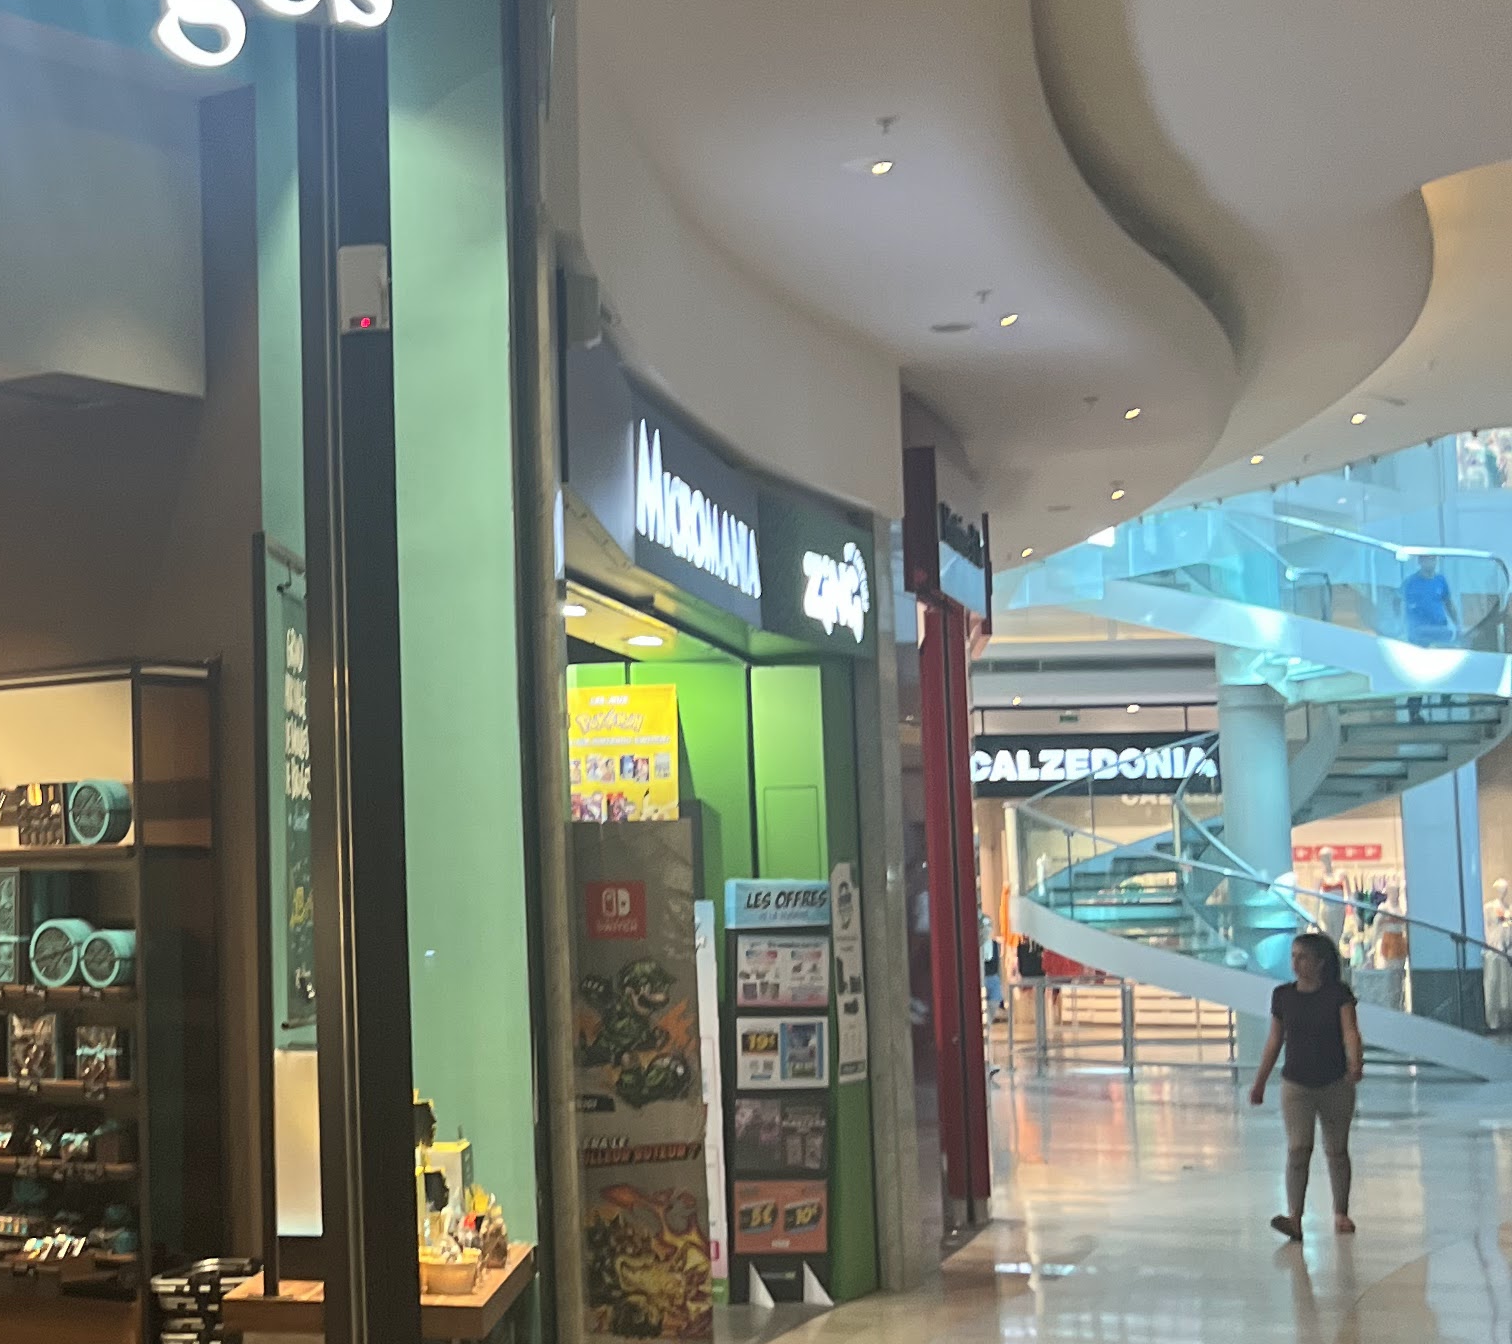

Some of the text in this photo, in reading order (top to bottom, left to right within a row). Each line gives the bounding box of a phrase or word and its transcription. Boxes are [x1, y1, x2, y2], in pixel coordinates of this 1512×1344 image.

[970, 747, 1218, 783] CALZEDONIA
[745, 889, 828, 910] LES OFFRES
